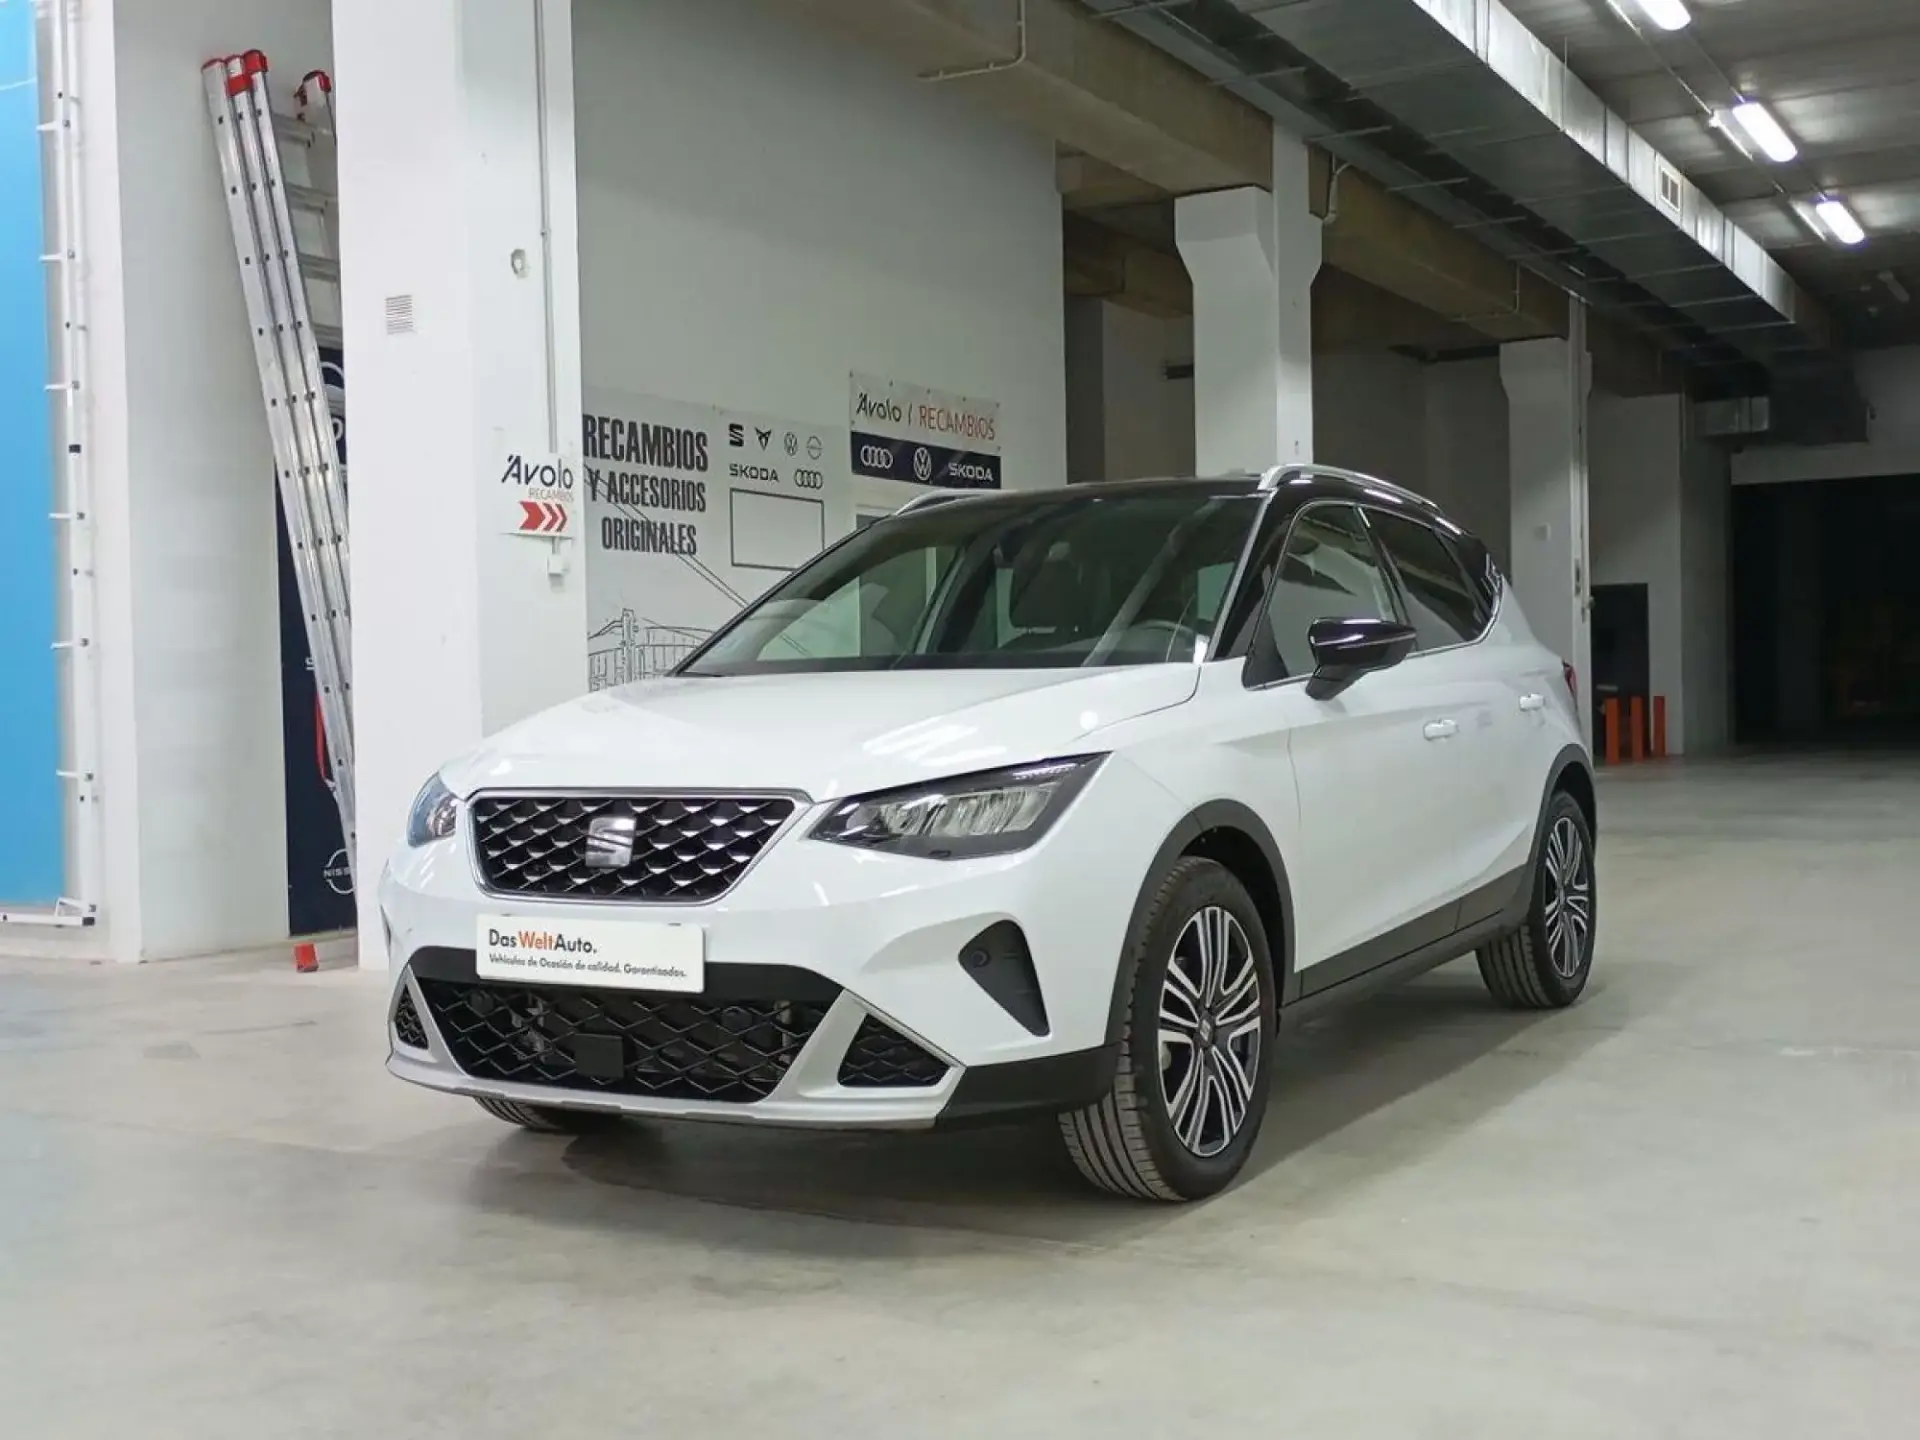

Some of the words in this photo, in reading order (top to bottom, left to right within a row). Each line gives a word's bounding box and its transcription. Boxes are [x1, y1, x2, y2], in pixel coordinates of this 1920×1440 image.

[918, 405, 996, 441] RECAMBIOS
[582, 414, 708, 473] RECAMBIOS
[588, 469, 601, 502] Y
[607, 471, 707, 513] ACCESORIOS
[729, 462, 780, 483] SKODA
[602, 516, 697, 555] ORIGINALES
[528, 956, 538, 967] de
[575, 960, 586, 971] de
